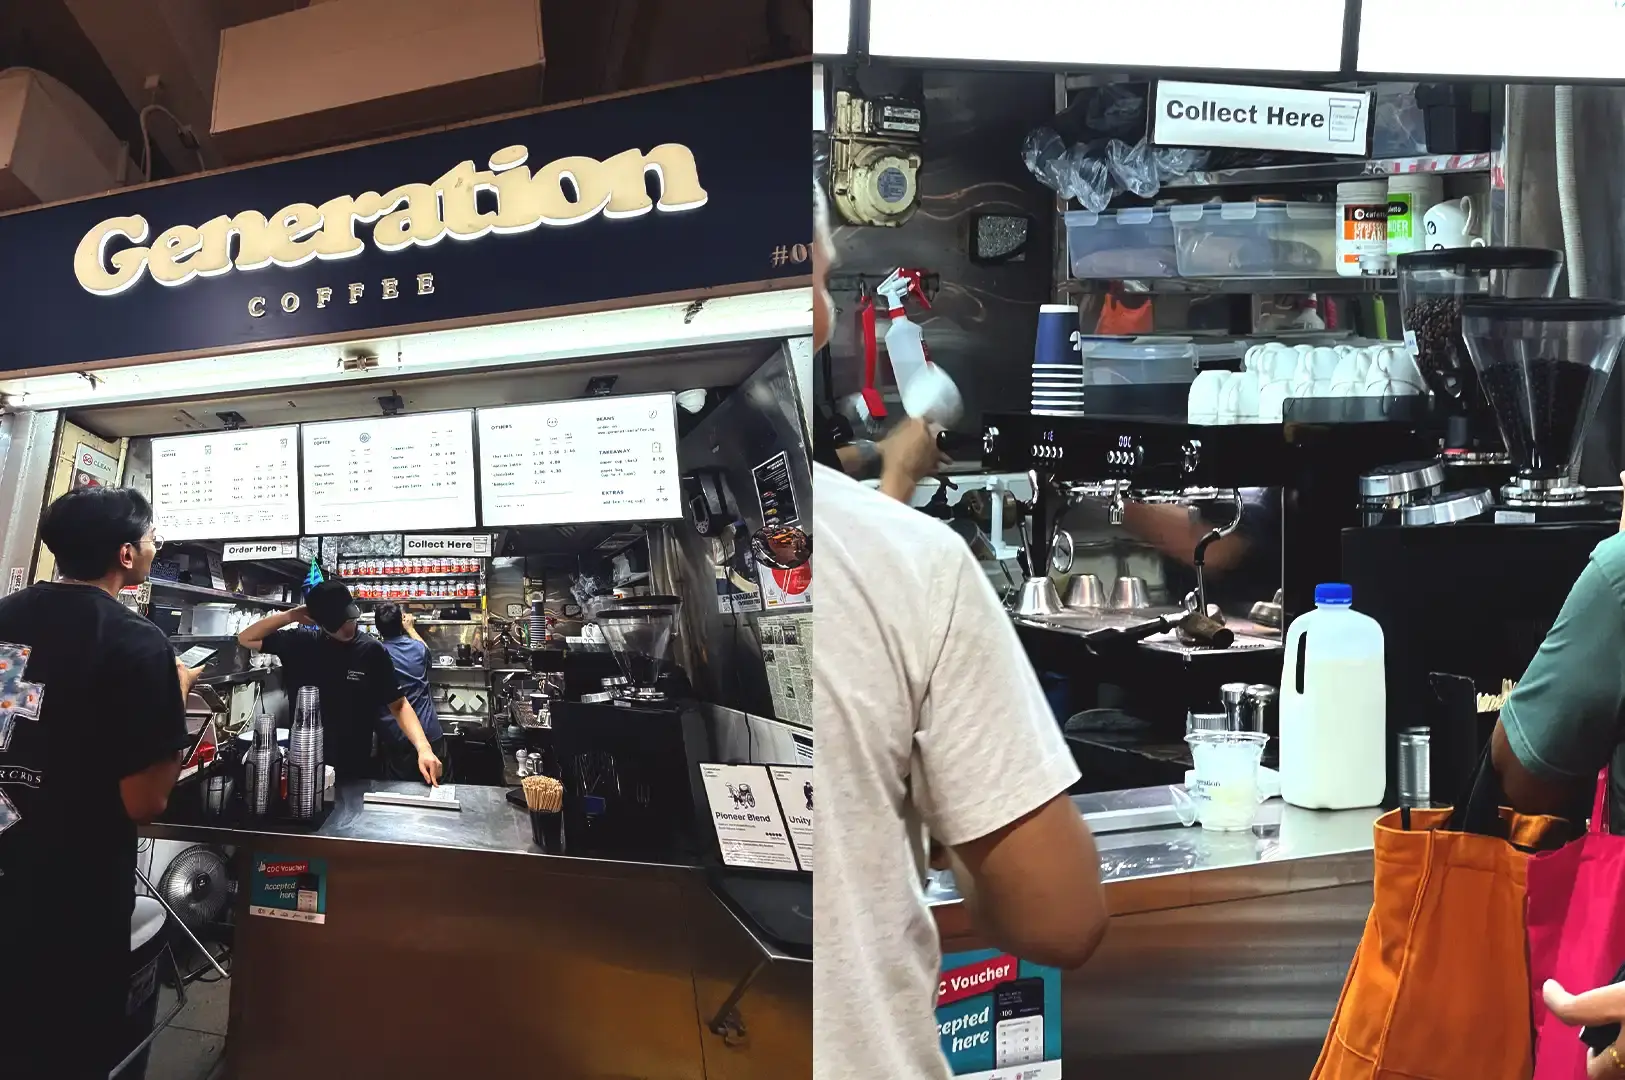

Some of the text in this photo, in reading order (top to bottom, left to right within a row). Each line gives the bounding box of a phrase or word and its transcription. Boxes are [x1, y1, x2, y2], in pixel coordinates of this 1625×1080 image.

[1166, 100, 1258, 124] Collect
[1267, 106, 1324, 128] Here
[74, 142, 708, 296] Generation
[247, 272, 435, 318] COFFEE
[94, 460, 111, 472] CLEAN
[229, 546, 253, 554] Order
[408, 540, 472, 548] Collect Here
[715, 811, 771, 823] Pioneer Blend
[789, 816, 811, 826] Unity
[264, 882, 296, 890] Accepted
[950, 964, 1010, 991] Voucher
[952, 1030, 989, 1053] here
